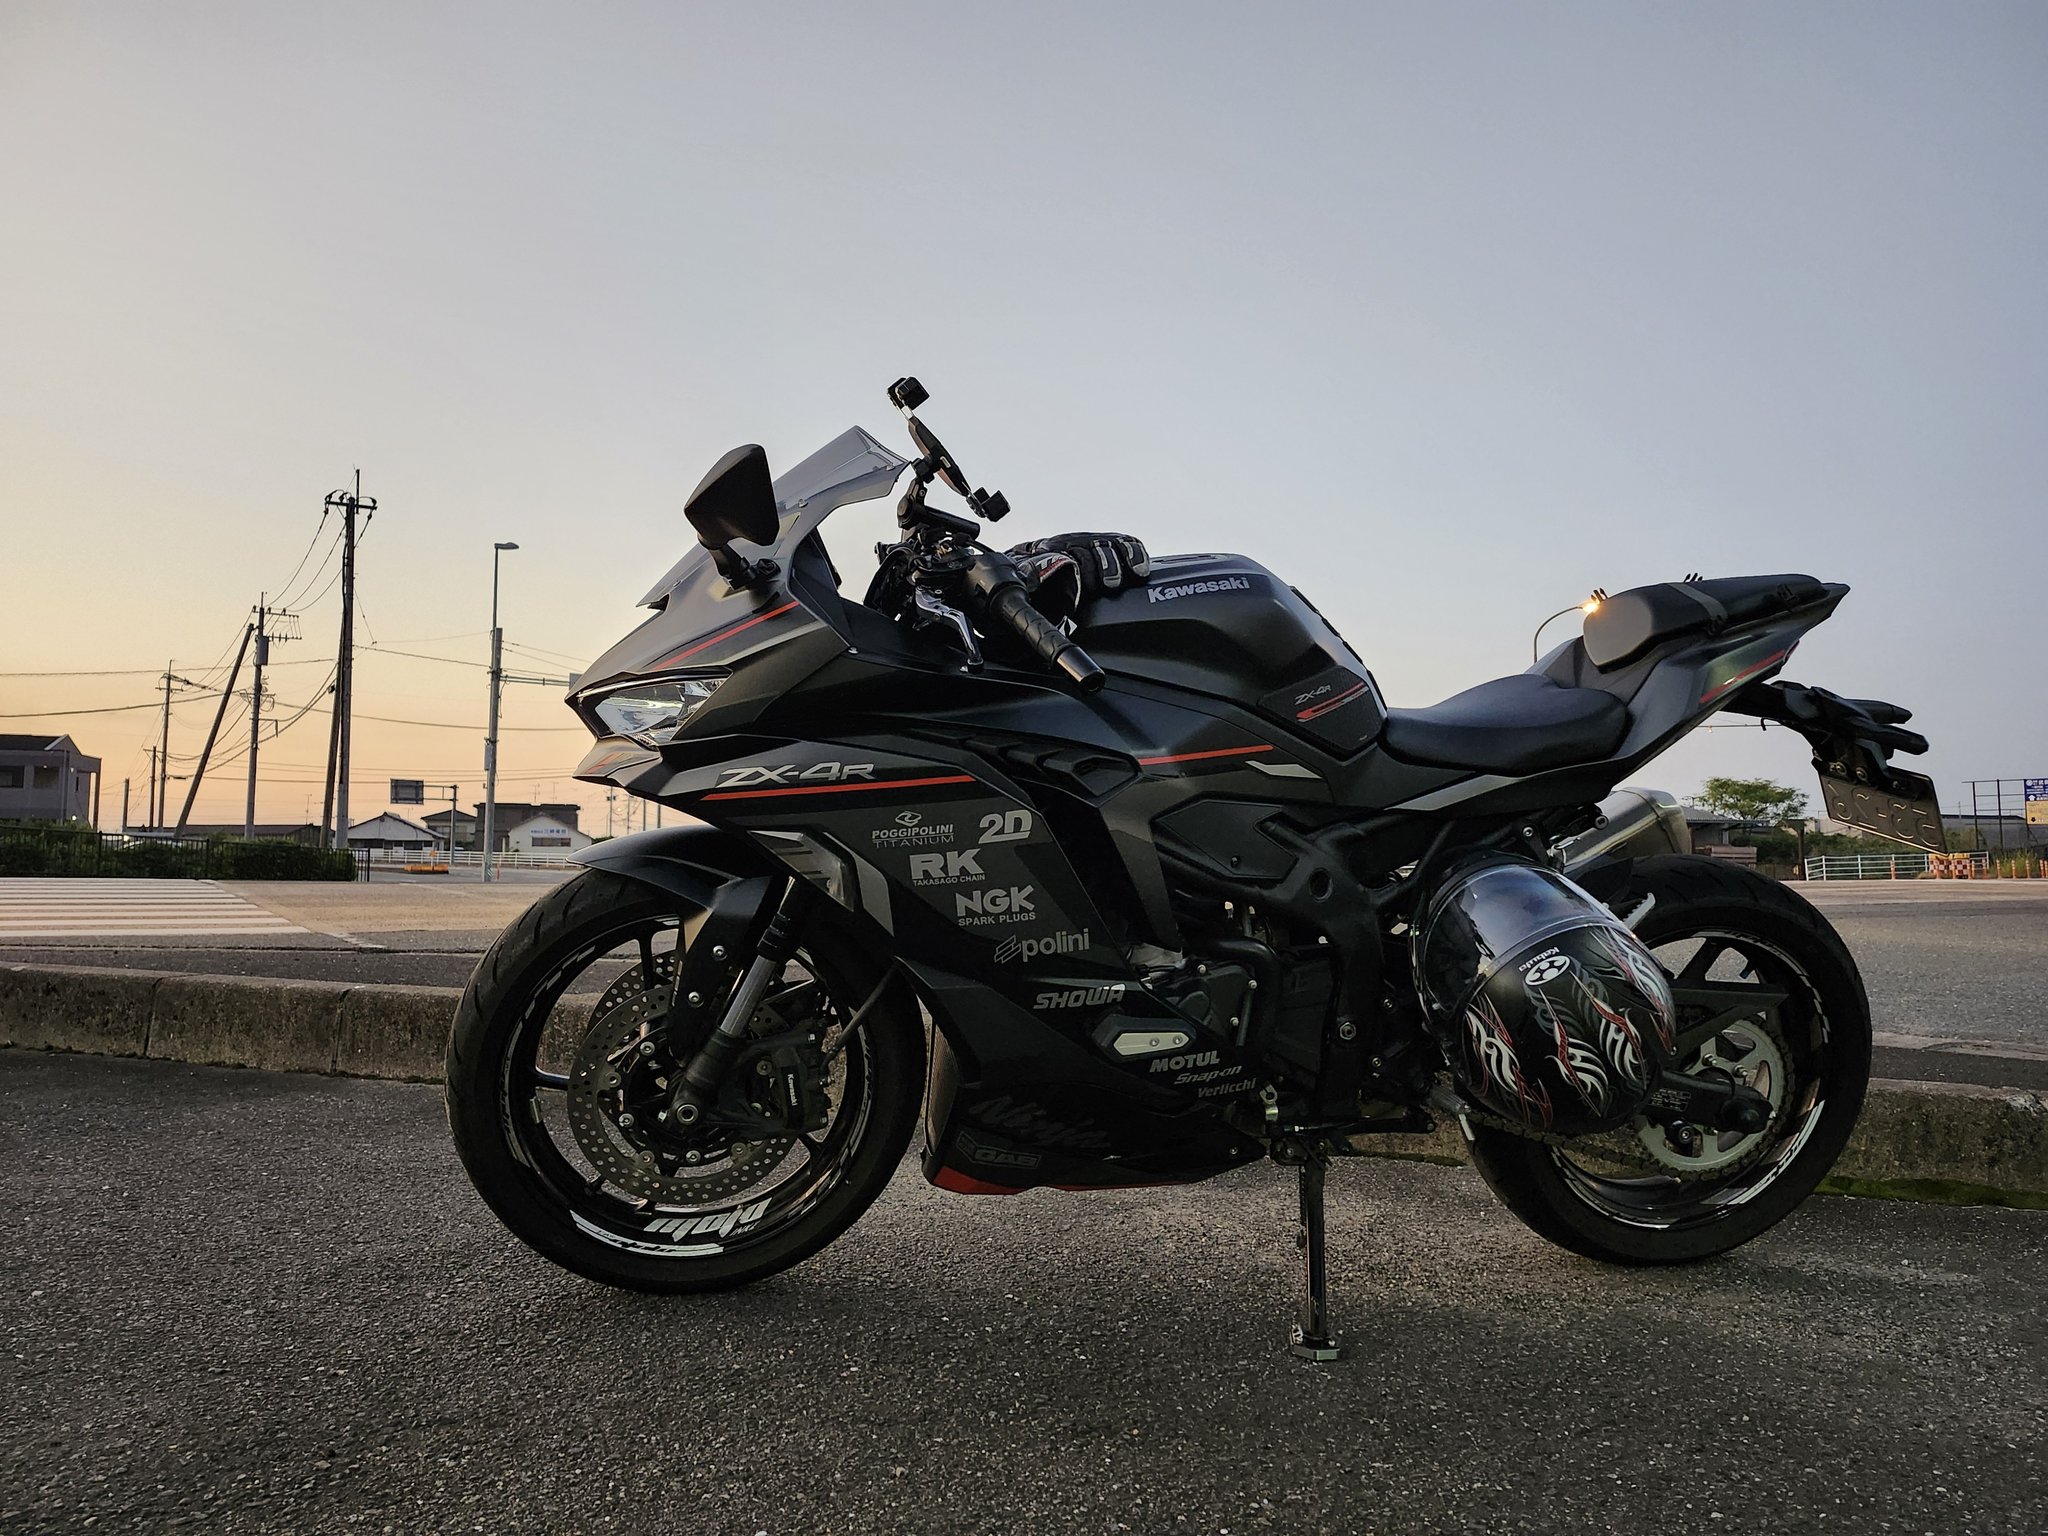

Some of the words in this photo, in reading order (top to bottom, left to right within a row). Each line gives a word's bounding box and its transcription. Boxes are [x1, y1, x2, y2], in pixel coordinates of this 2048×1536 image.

[1148, 577, 1250, 603] Kawasaki
[1295, 684, 1332, 705] ZX-4R
[716, 762, 876, 788] ZX-4R
[872, 824, 954, 839] POGGIPOLINI
[978, 810, 1033, 844] 2D
[873, 836, 954, 849] TITANIUM
[909, 848, 985, 880] RK
[913, 876, 957, 886] TAKASAGO
[959, 873, 986, 884] CHAIN
[955, 884, 1035, 917] NGK
[958, 915, 996, 926] SPARK
[999, 911, 1036, 923] PLUGS
[1021, 928, 1090, 962] polini
[1033, 983, 1126, 1010] SHOWA
[1149, 1050, 1220, 1073] MOTUL
[1173, 1065, 1242, 1085] Snap-on
